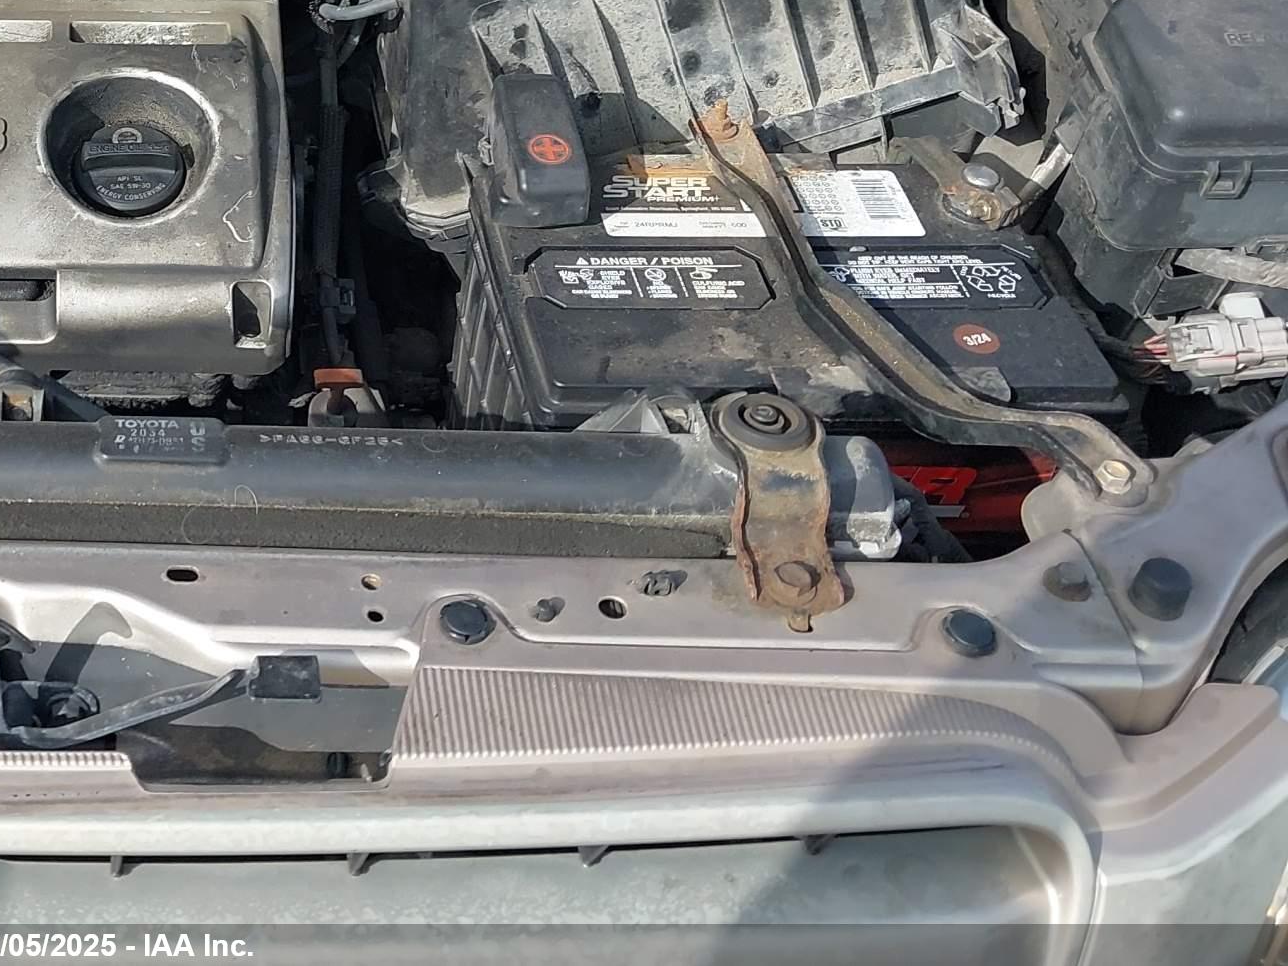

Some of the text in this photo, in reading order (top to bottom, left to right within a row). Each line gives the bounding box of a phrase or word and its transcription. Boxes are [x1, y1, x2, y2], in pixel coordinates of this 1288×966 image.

[612, 175, 708, 187] SUPER
[602, 184, 711, 198] START
[590, 257, 648, 265] DANGER
[661, 257, 714, 265] POISON
[114, 418, 179, 429] TOYOTA
